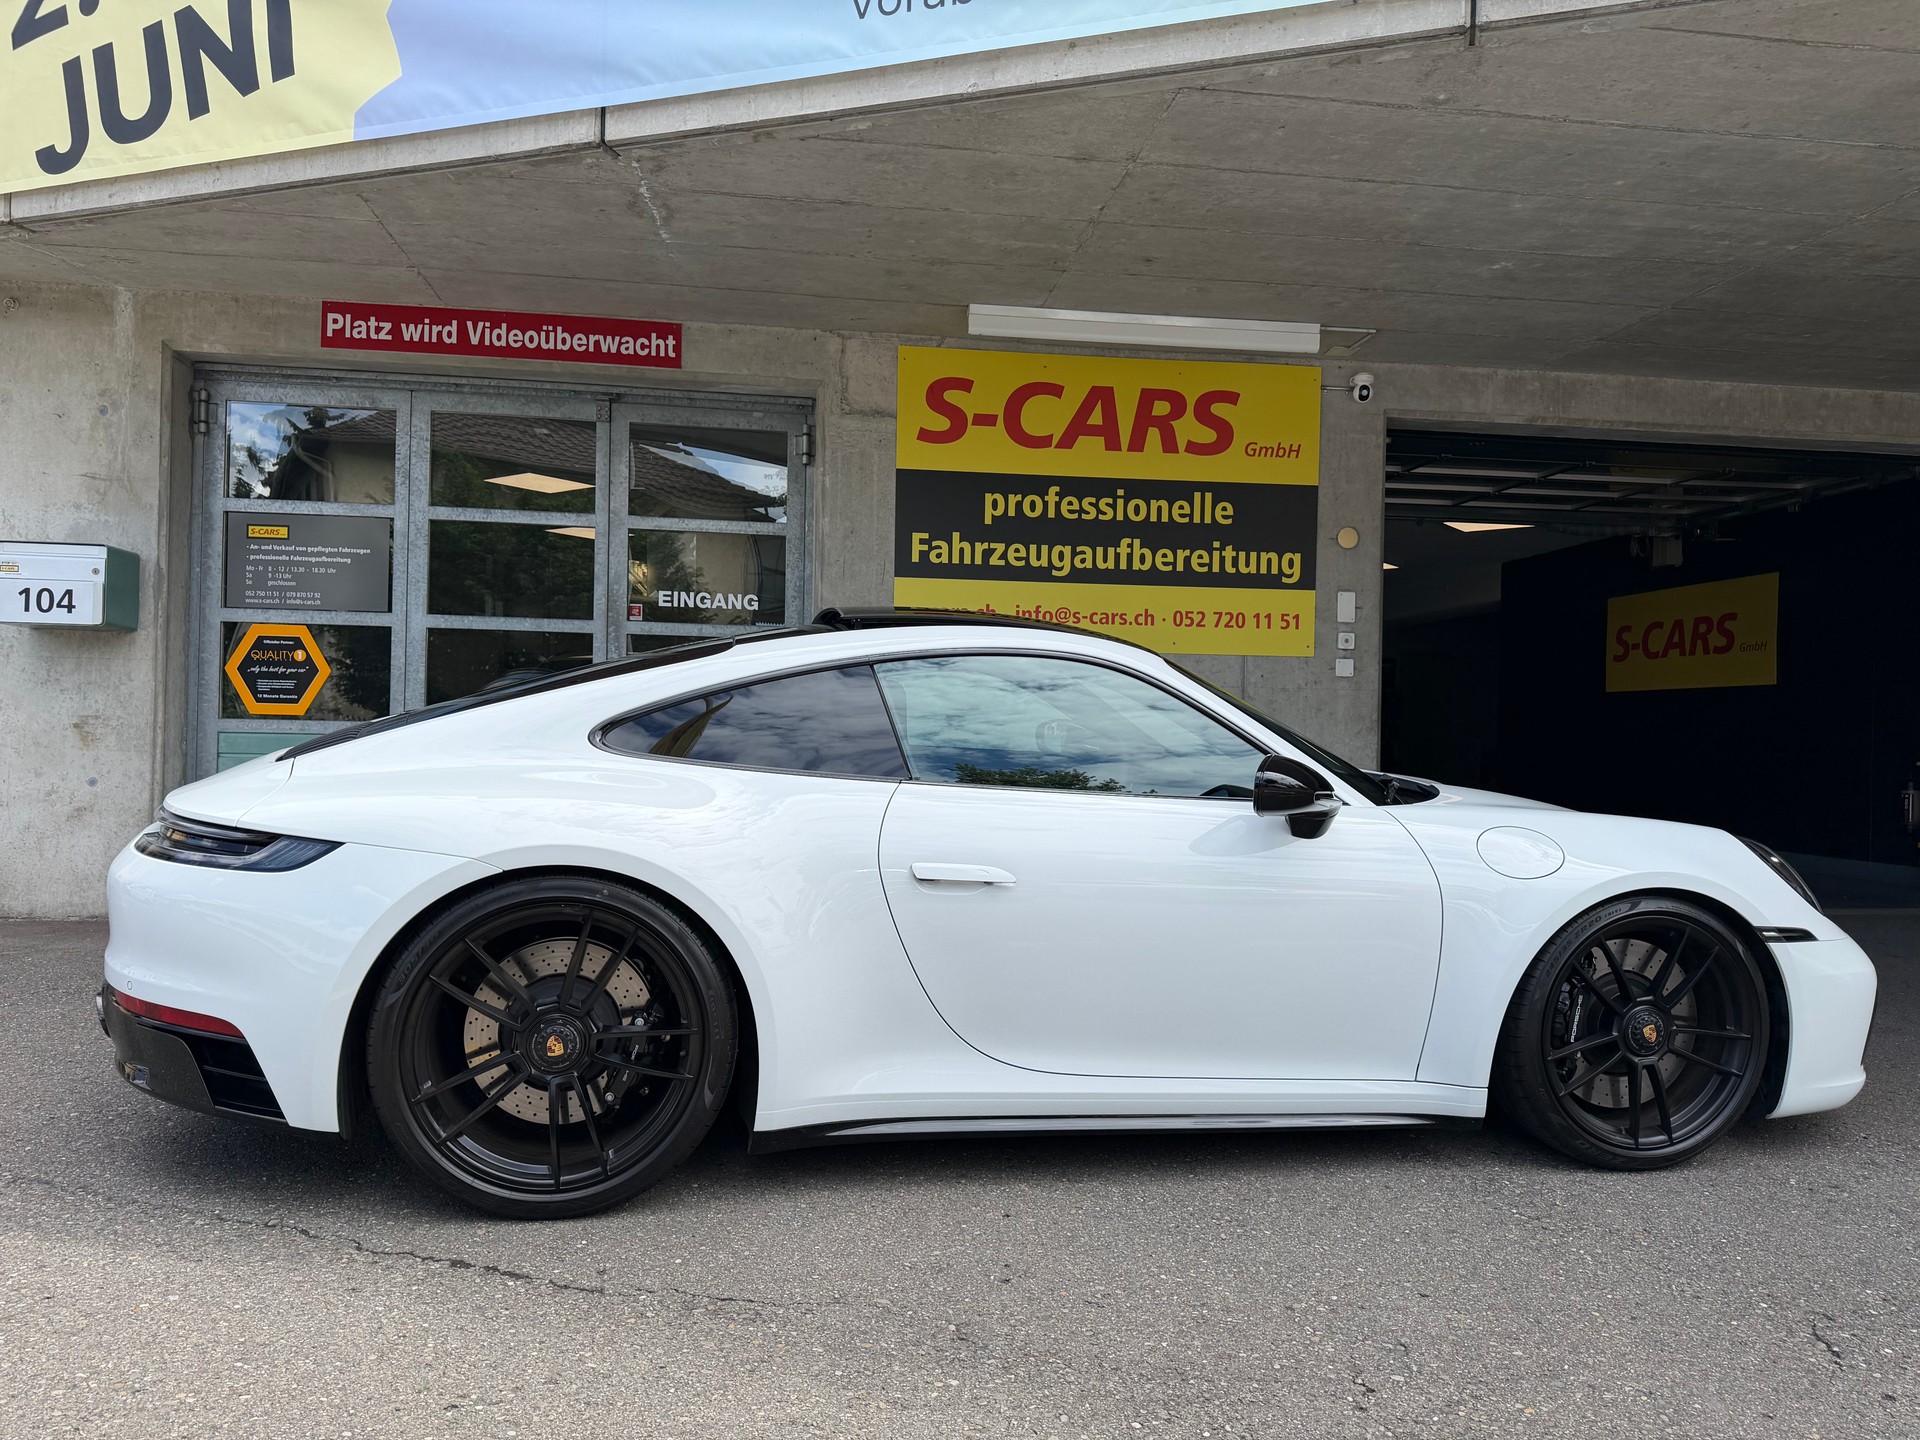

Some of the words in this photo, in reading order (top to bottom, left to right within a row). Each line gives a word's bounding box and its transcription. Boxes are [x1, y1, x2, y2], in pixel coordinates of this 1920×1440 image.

[35, 0, 296, 176] JUNI
[326, 312, 393, 340] Platz
[401, 318, 458, 344] wird
[466, 320, 677, 358] Videoüberwacht
[916, 376, 1241, 457] S-CARS
[1244, 441, 1302, 460] GmbH
[983, 485, 1235, 525] professionelle
[250, 528, 280, 536] S-CARS
[910, 531, 1302, 584] Fahrzeugaufbereitung
[267, 579, 297, 587] geschlossen
[18, 587, 76, 614] 104
[658, 590, 759, 611] EINGANG
[1014, 603, 1156, 628] info@s-cars.ch
[1173, 609, 1207, 629] 052
[1213, 611, 1246, 630] 720
[1252, 612, 1271, 630] 11
[1279, 612, 1301, 631] 51
[1612, 611, 1739, 663] S-CARS
[1739, 640, 1768, 653] GmbH
[251, 649, 294, 660] QUALITY
